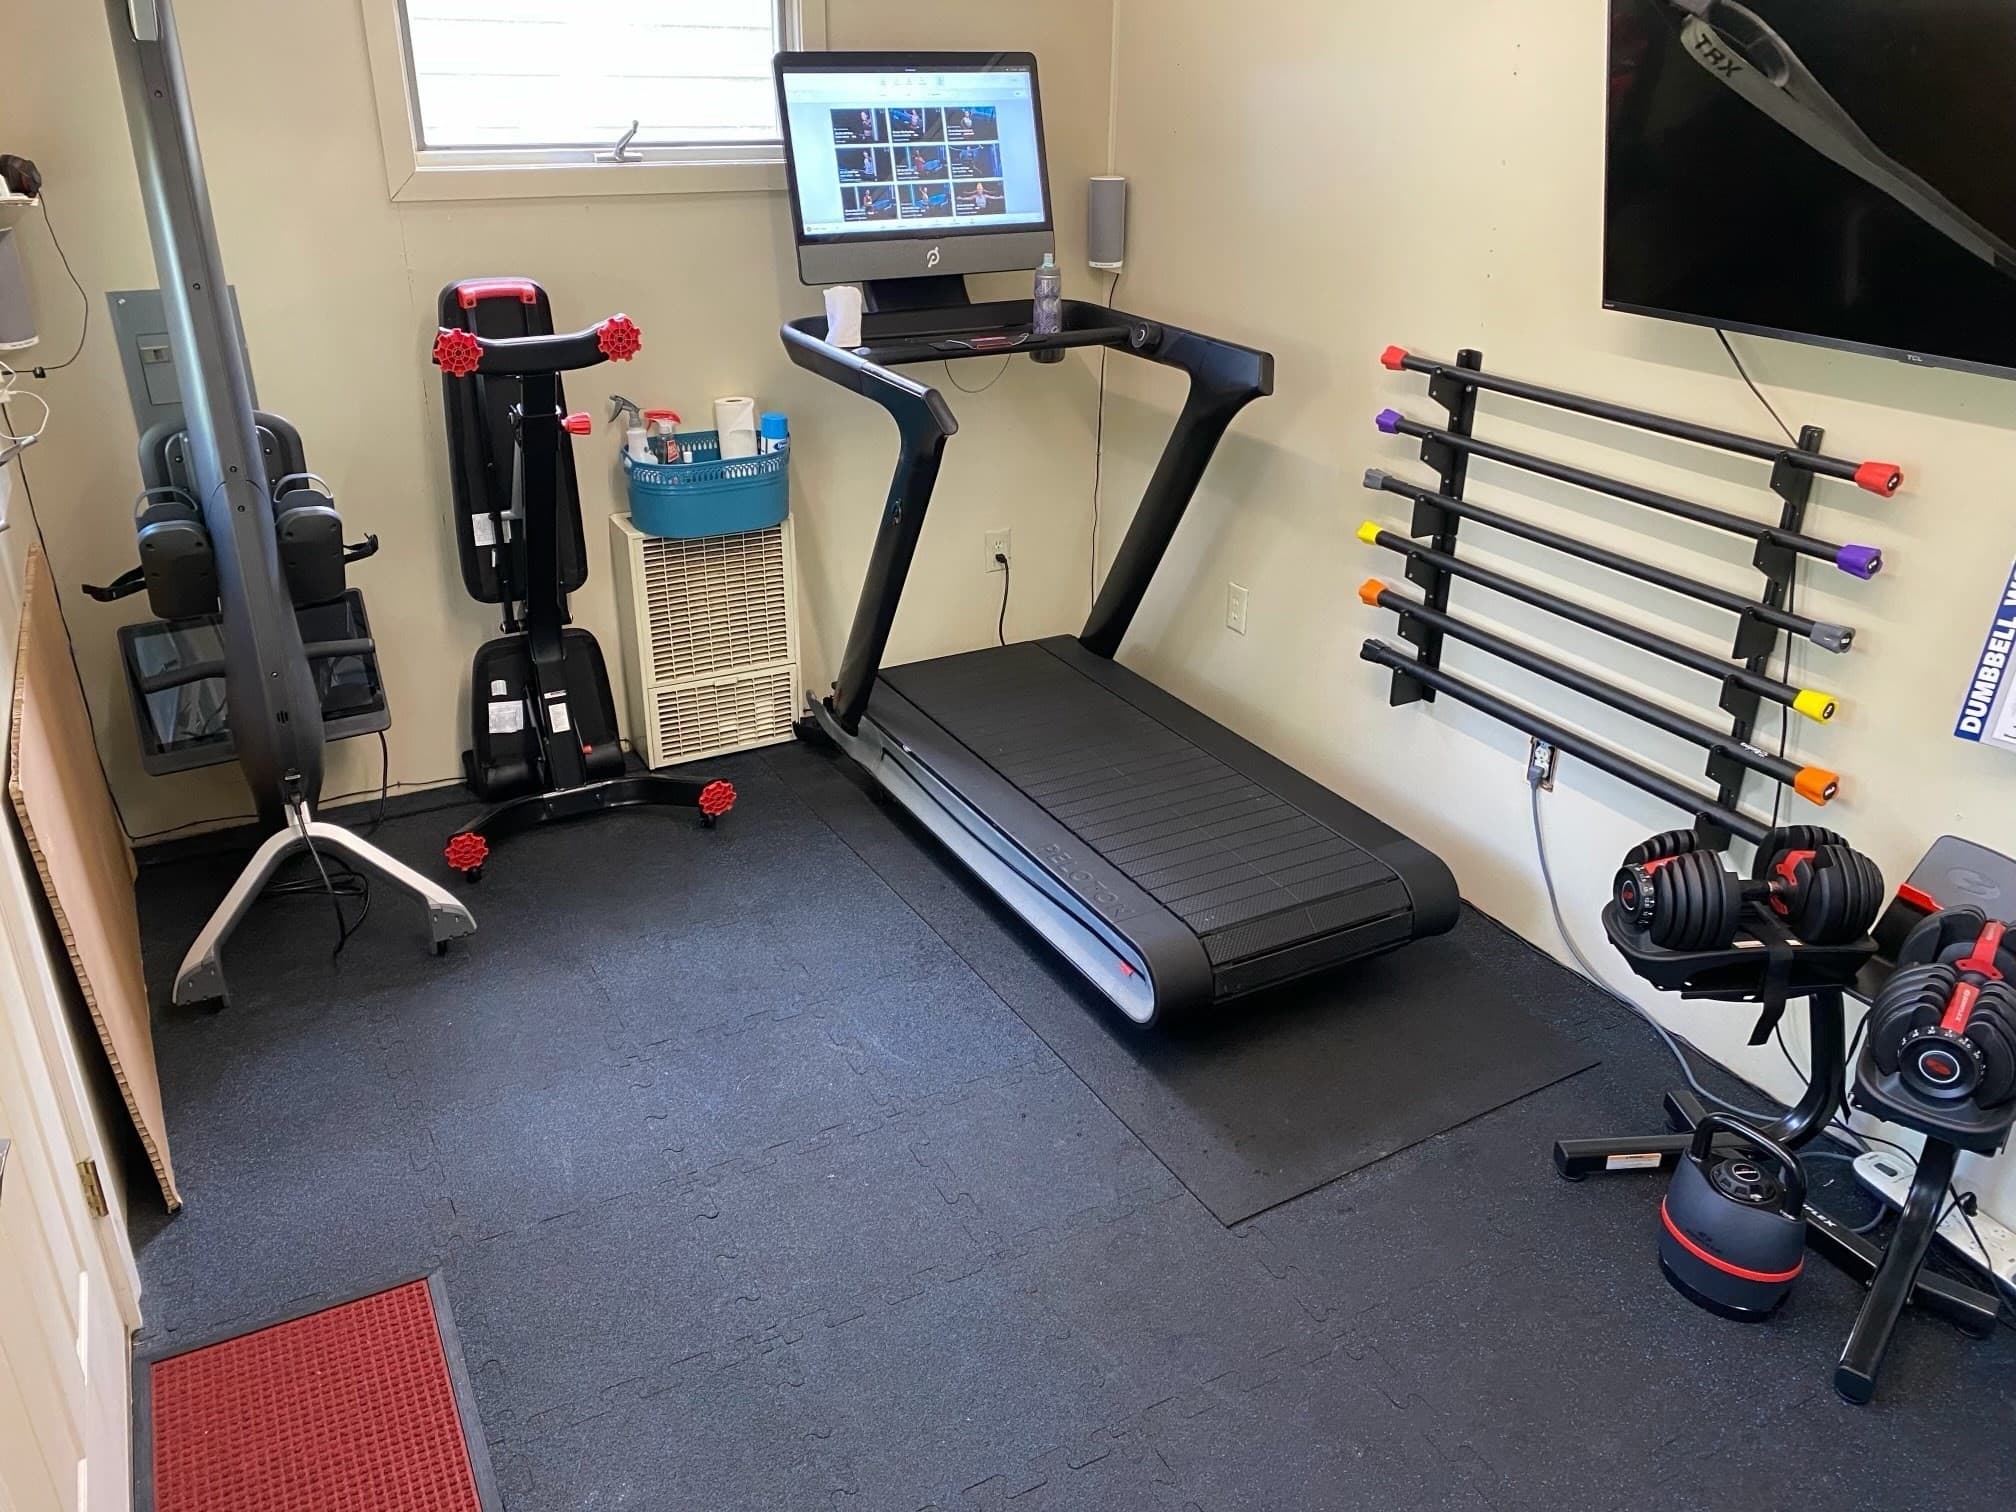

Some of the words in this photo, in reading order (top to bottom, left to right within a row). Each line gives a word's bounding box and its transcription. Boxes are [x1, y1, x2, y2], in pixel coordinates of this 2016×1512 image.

[1695, 33, 1742, 77] TRX
[1906, 354, 1924, 362] TCL
[1959, 616, 2016, 735] DUMBBELL
[1040, 843, 1136, 920] PELOTON
[1802, 1203, 1838, 1227] FLEX
